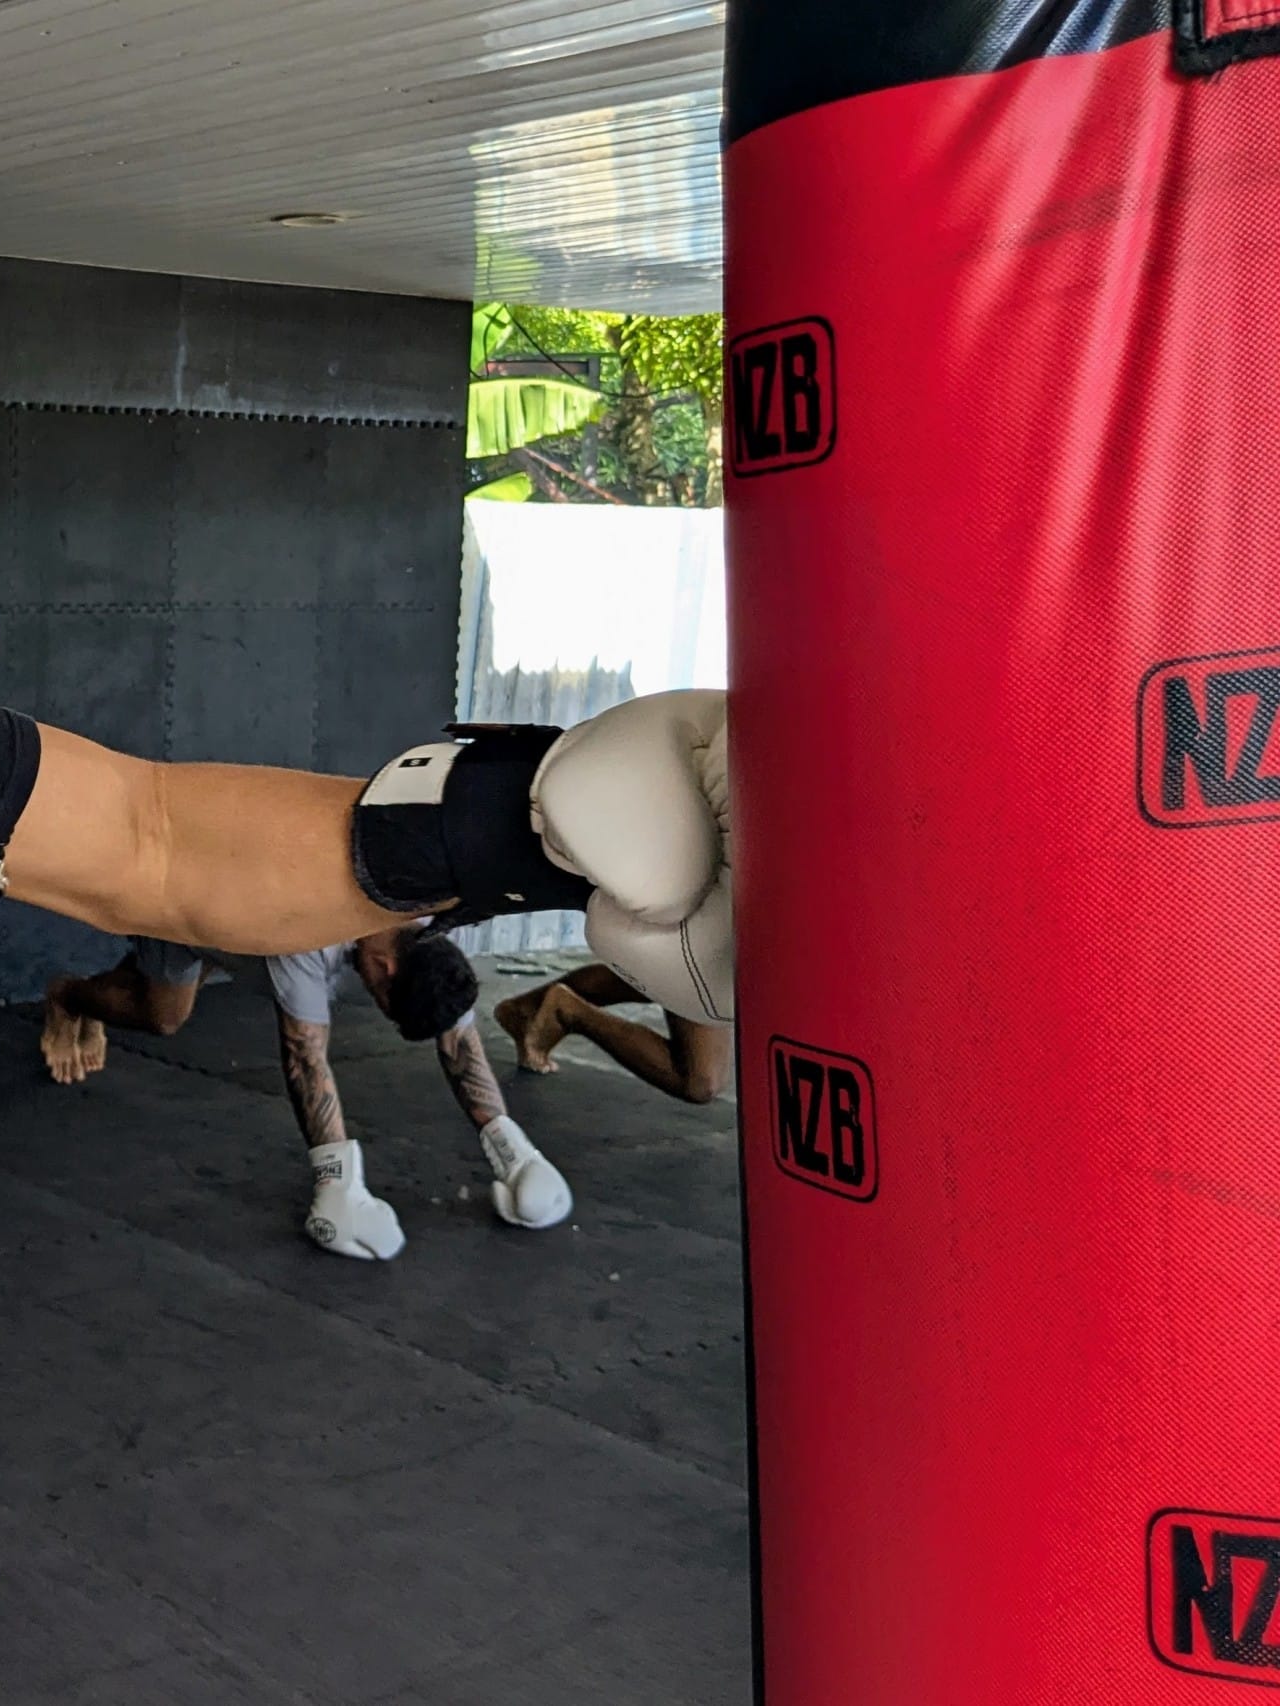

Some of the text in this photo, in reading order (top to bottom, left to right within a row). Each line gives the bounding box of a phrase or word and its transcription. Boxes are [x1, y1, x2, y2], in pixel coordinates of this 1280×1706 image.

[731, 332, 820, 464] NZB
[1163, 666, 1280, 811] NZ
[775, 1049, 865, 1187] NZB
[1172, 1524, 1280, 1670] NZ
